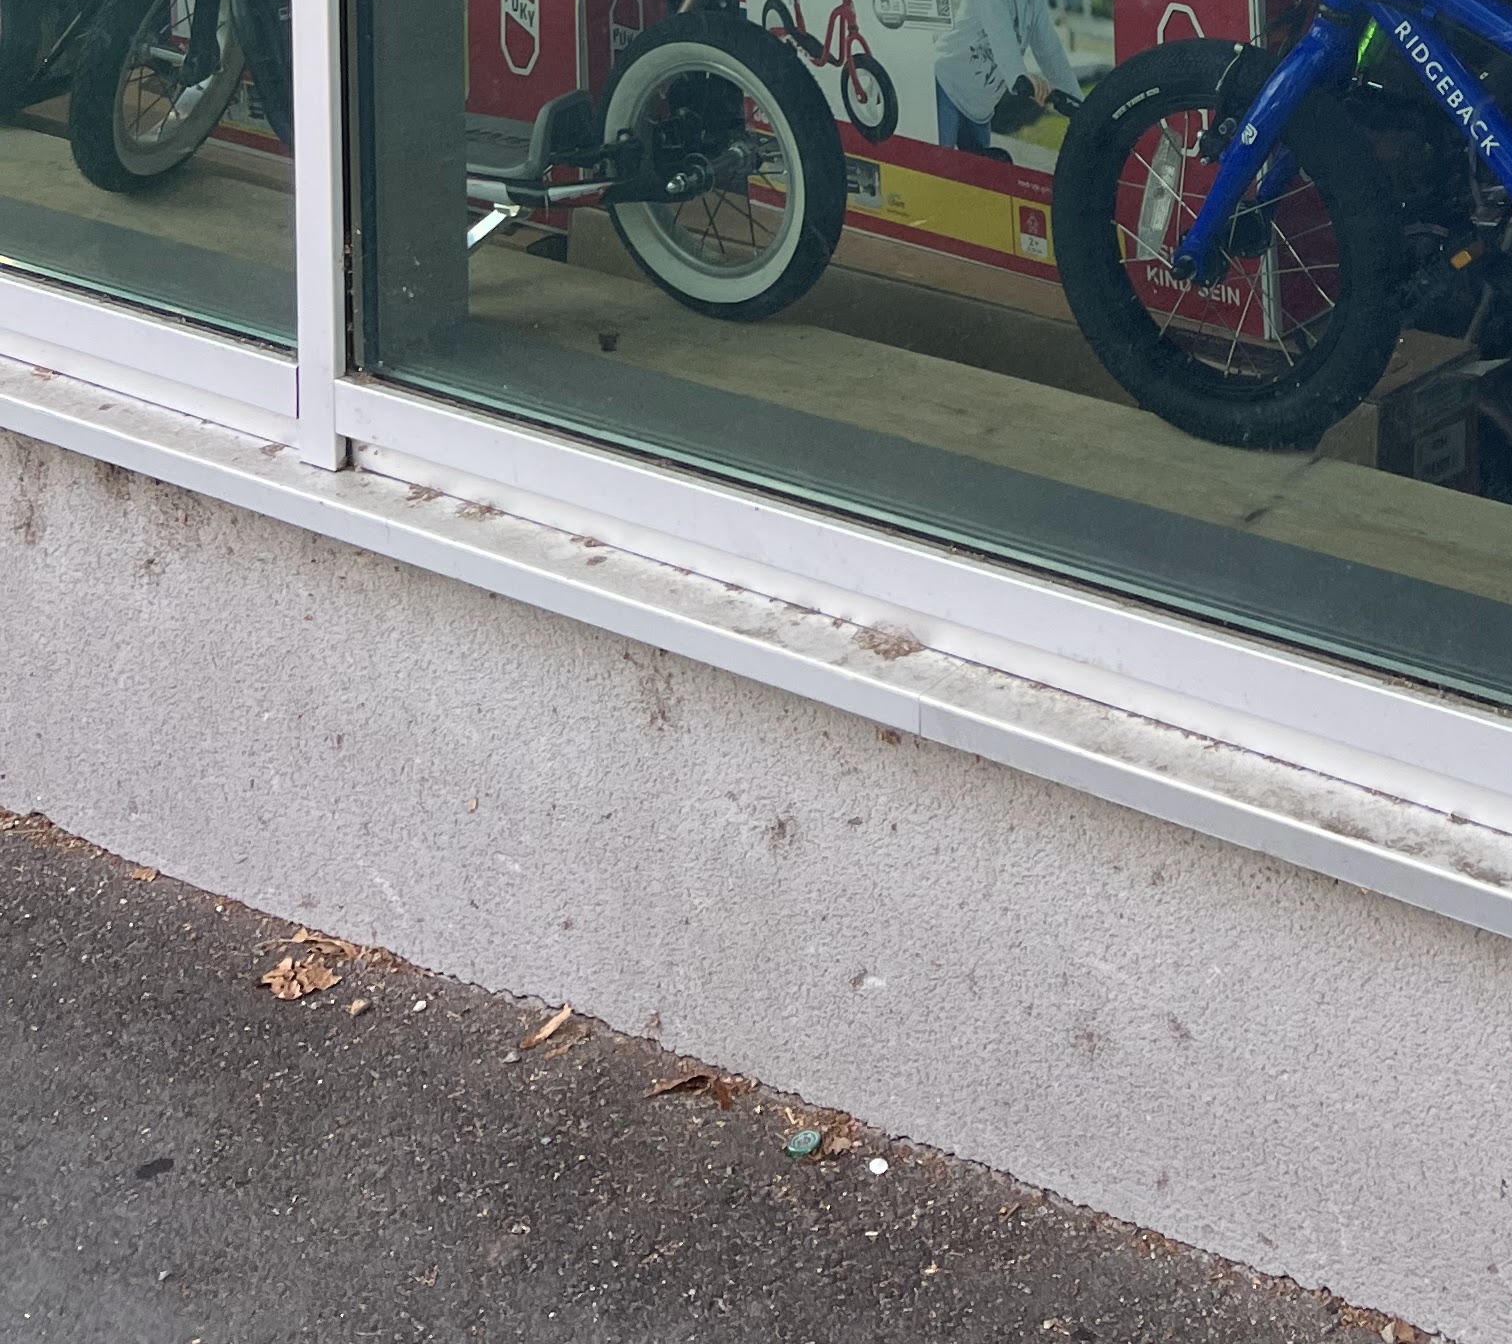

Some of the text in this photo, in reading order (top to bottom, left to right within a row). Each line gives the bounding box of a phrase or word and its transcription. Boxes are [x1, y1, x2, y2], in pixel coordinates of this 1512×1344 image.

[612, 27, 638, 46] PUK
[1394, 20, 1501, 157] RIDGEBACK
[1146, 264, 1194, 293] KIND
